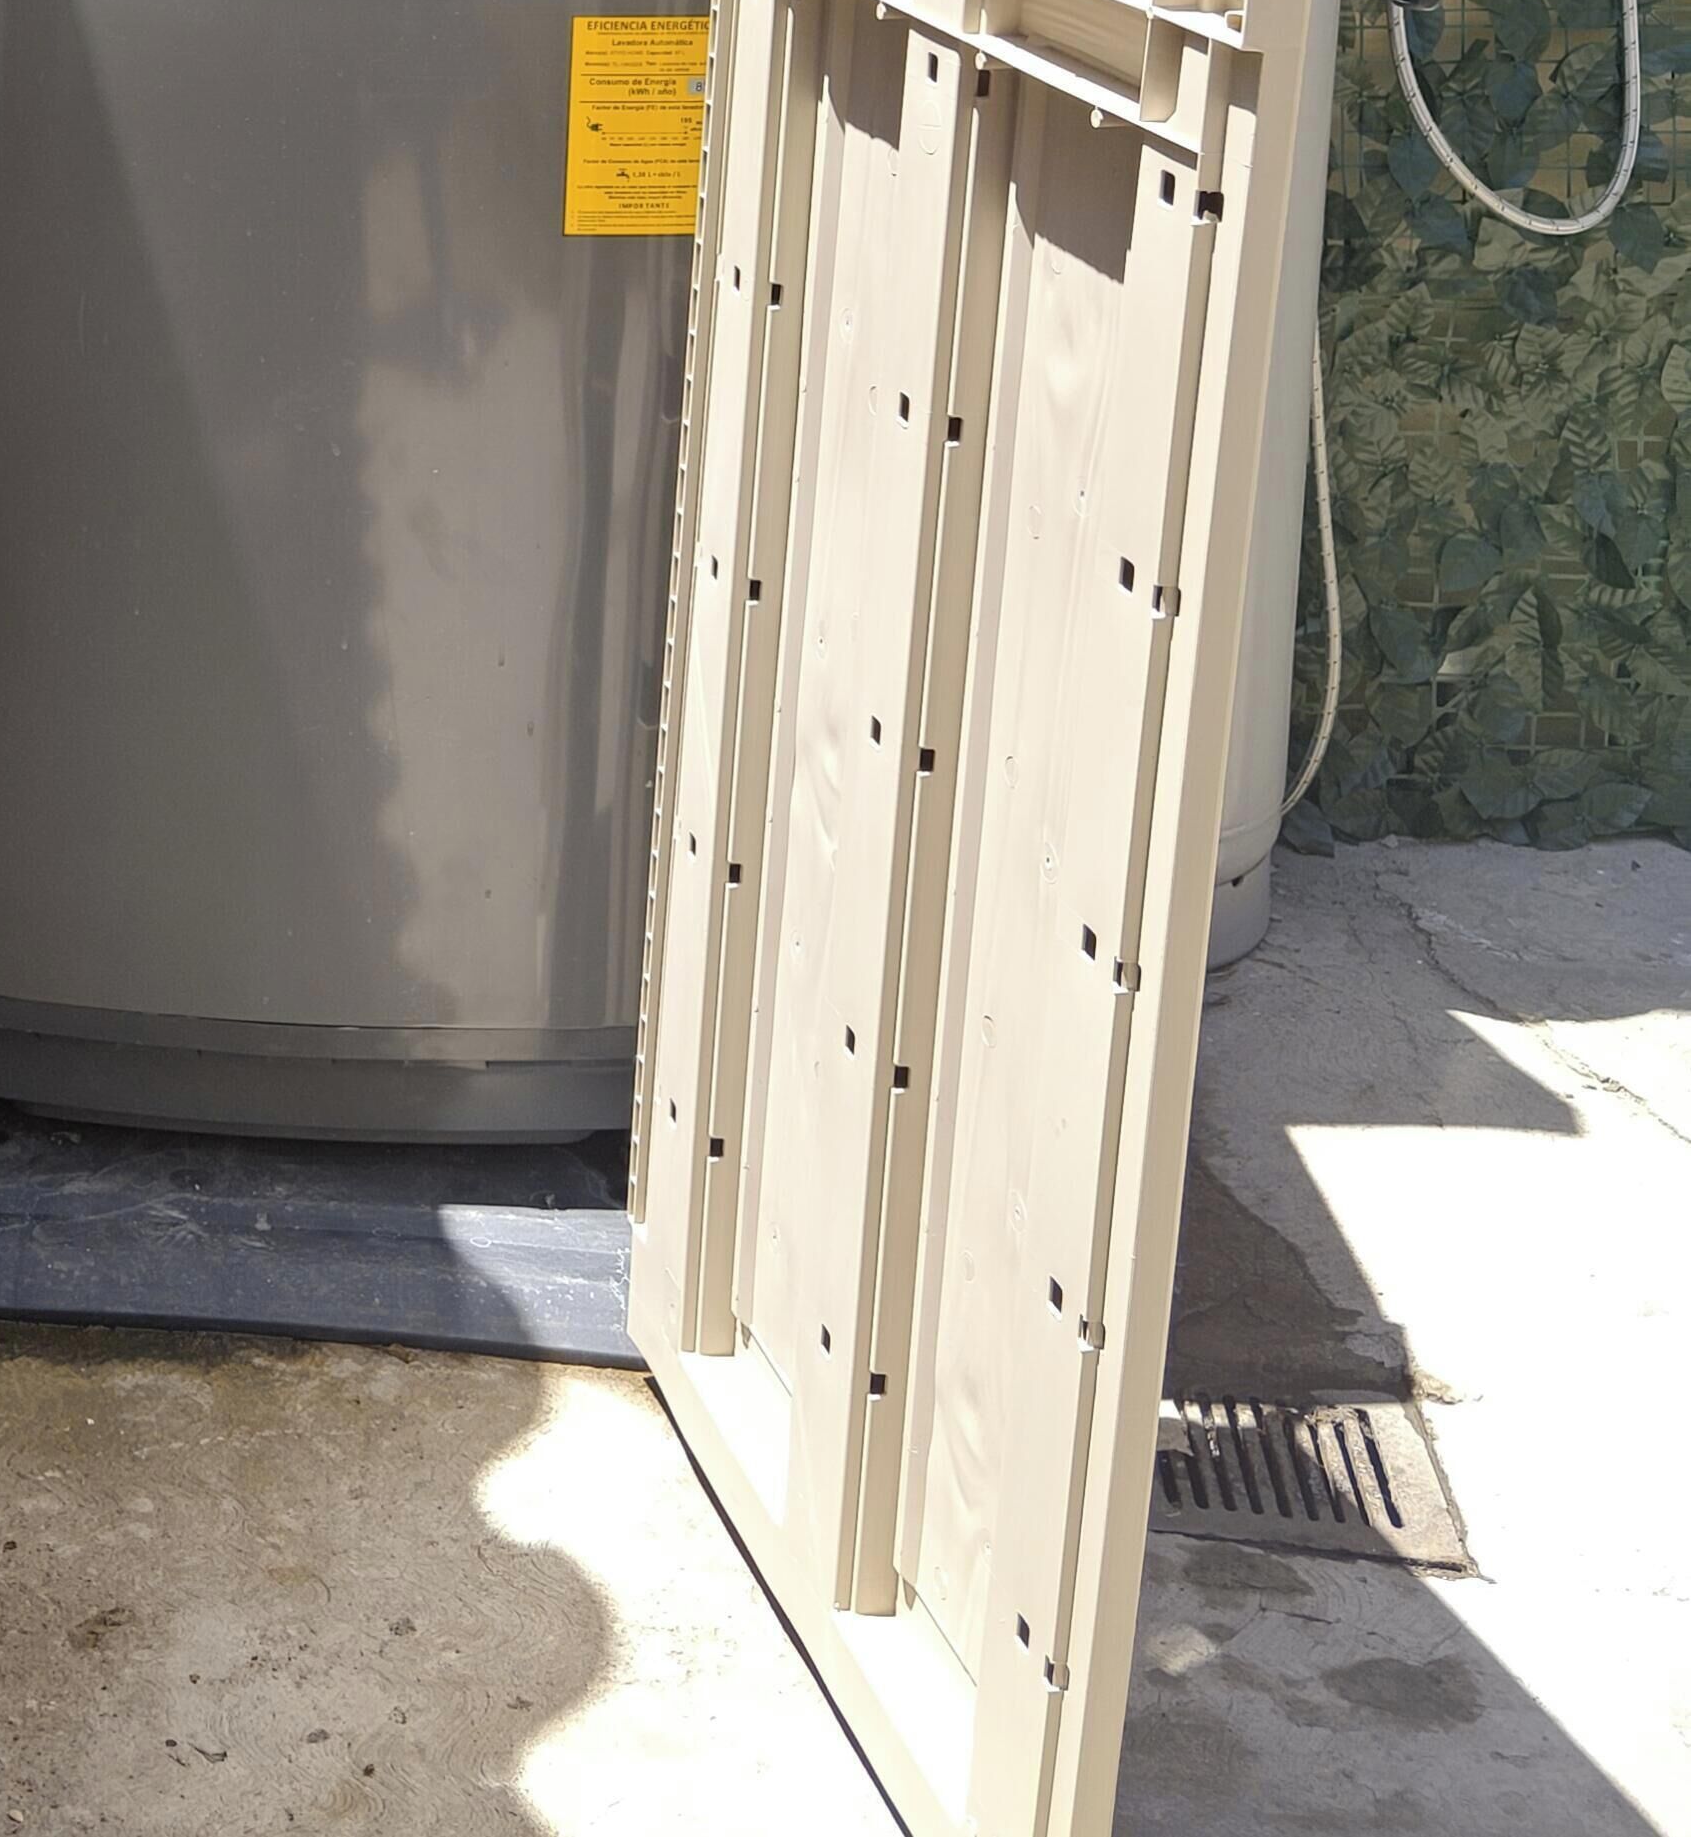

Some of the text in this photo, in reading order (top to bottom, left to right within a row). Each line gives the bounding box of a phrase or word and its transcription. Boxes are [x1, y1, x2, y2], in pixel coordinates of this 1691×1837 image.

[587, 19, 709, 31] EFICIENCIA ENERGÉTIC
[589, 78, 629, 86] Consumo
[632, 78, 642, 86] de
